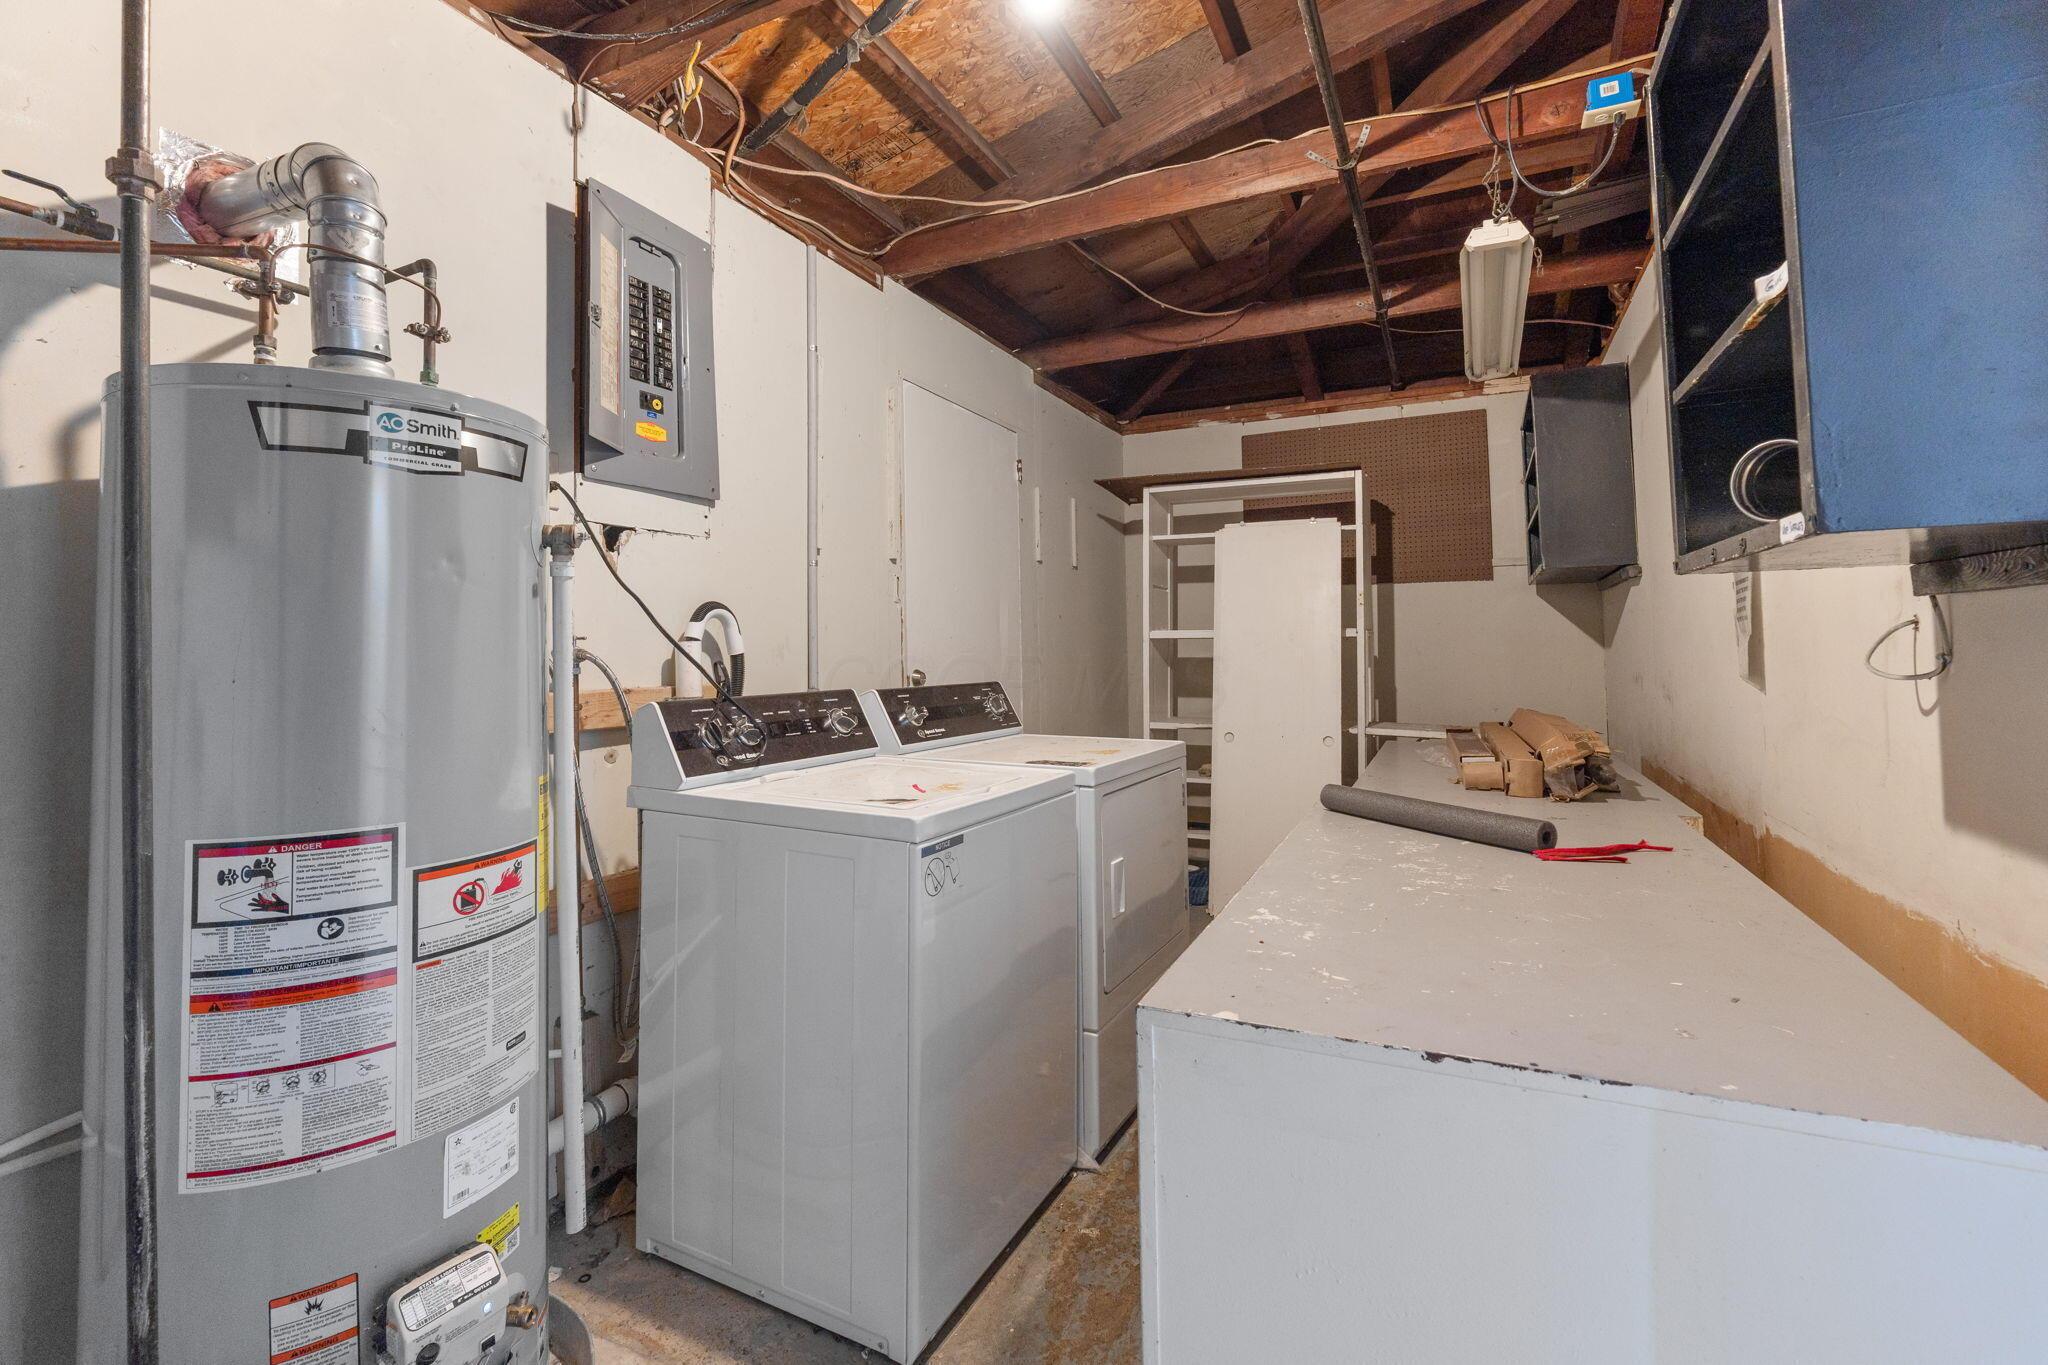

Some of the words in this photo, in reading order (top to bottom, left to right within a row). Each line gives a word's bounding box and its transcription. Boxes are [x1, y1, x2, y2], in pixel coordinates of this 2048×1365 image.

[378, 413, 405, 432] AO
[407, 419, 457, 440] Smith
[391, 442, 445, 457] ProLine
[281, 842, 322, 853] DANGER
[935, 840, 950, 850] NOTICE
[480, 856, 506, 867] WARNING
[252, 956, 340, 974] IMPORTANT/IMPORTANTE
[418, 1276, 440, 1290] STATUS
[440, 1266, 457, 1280] LIGHT
[457, 1258, 472, 1269] CODE
[296, 1282, 338, 1300] WARNING
[474, 1280, 493, 1294] OUTLET
[299, 1336, 338, 1356] WARNING
